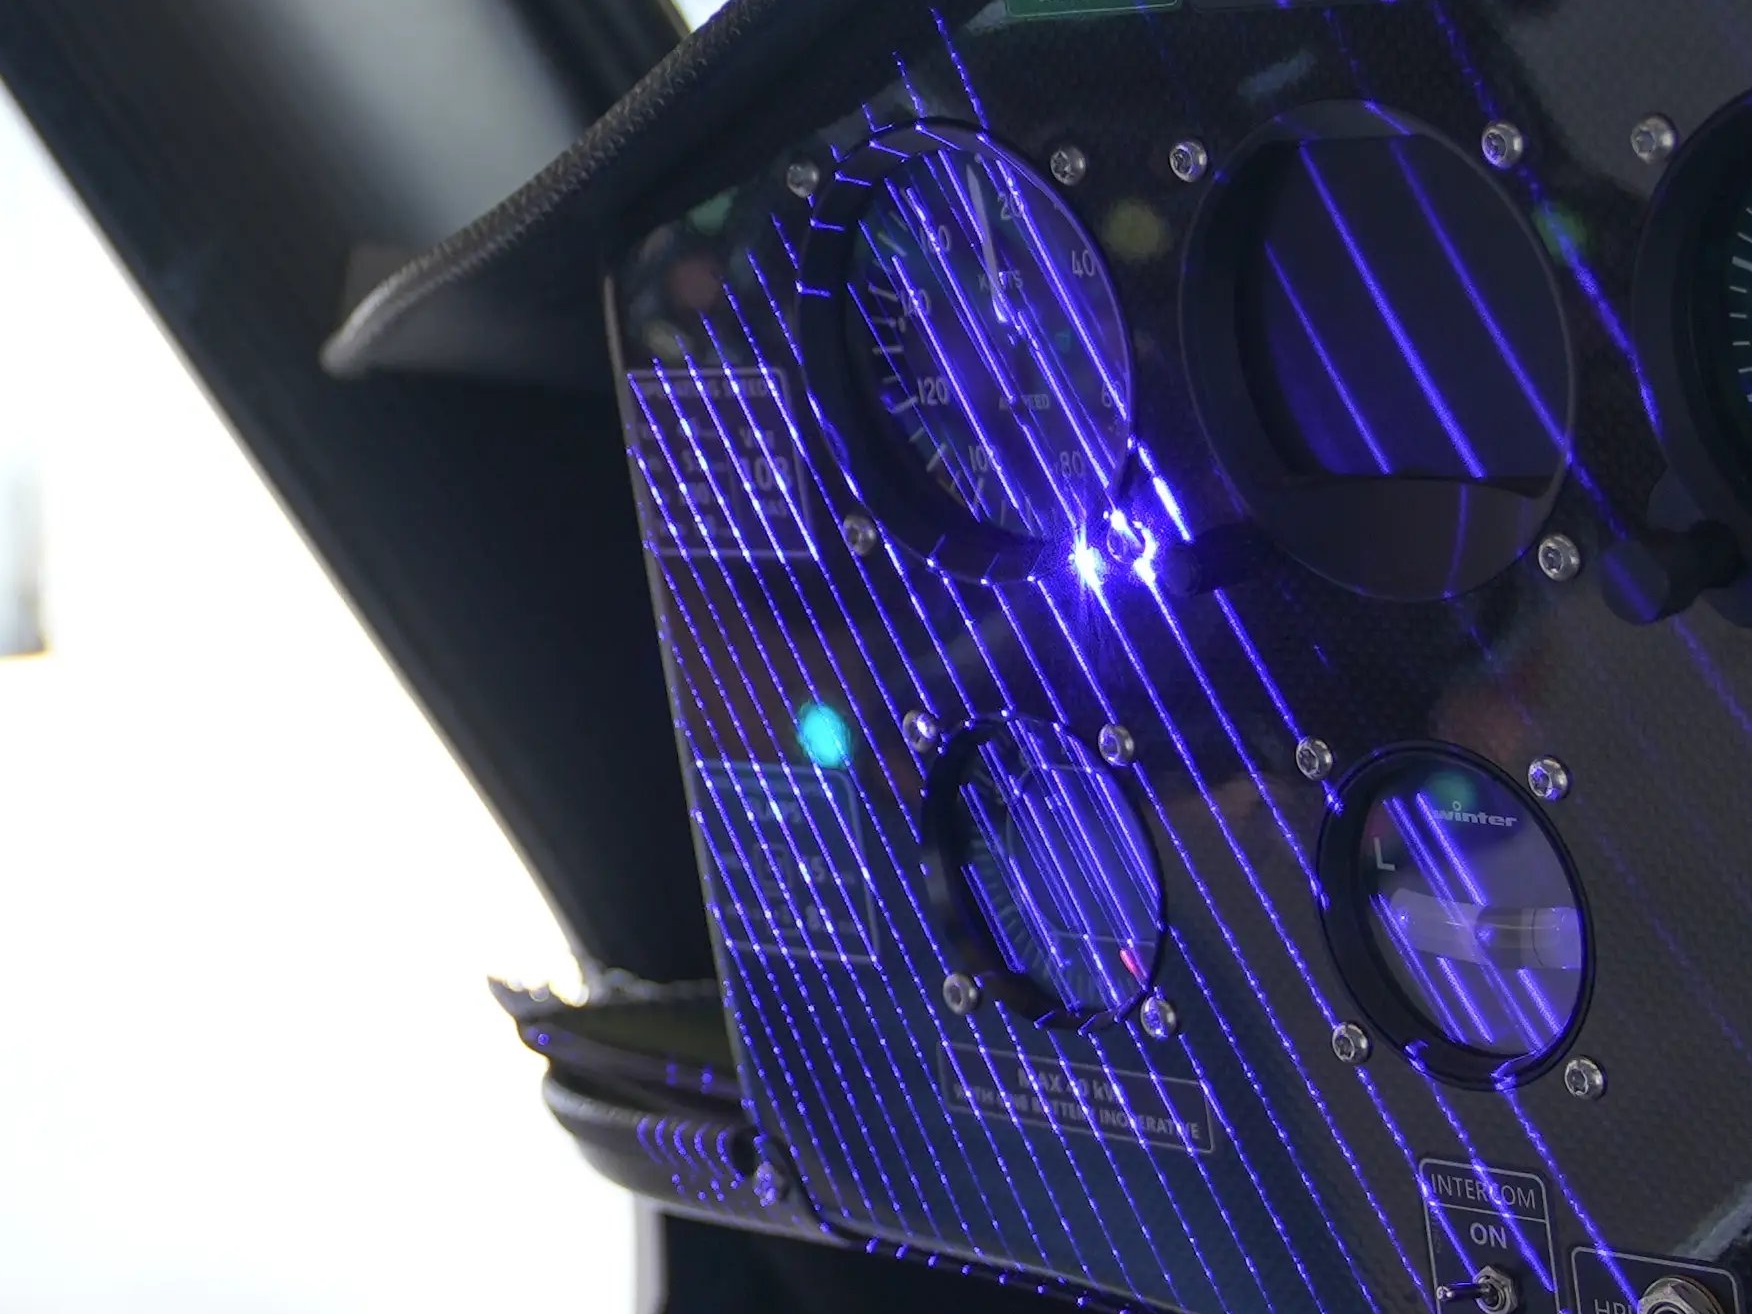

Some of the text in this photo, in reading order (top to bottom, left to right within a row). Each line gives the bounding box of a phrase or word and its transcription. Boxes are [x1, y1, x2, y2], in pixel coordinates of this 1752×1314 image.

[998, 191, 1025, 221] 20
[1072, 249, 1096, 278] 40
[978, 270, 1023, 292] KTS
[916, 376, 950, 405] 120
[1433, 801, 1518, 828] winter
[1374, 836, 1396, 872] L
[953, 1082, 994, 1105] WTH
[1032, 1096, 1096, 1123] BTTER
[1100, 1108, 1201, 1140] INOERATE
[1469, 1222, 1508, 1249] ON
